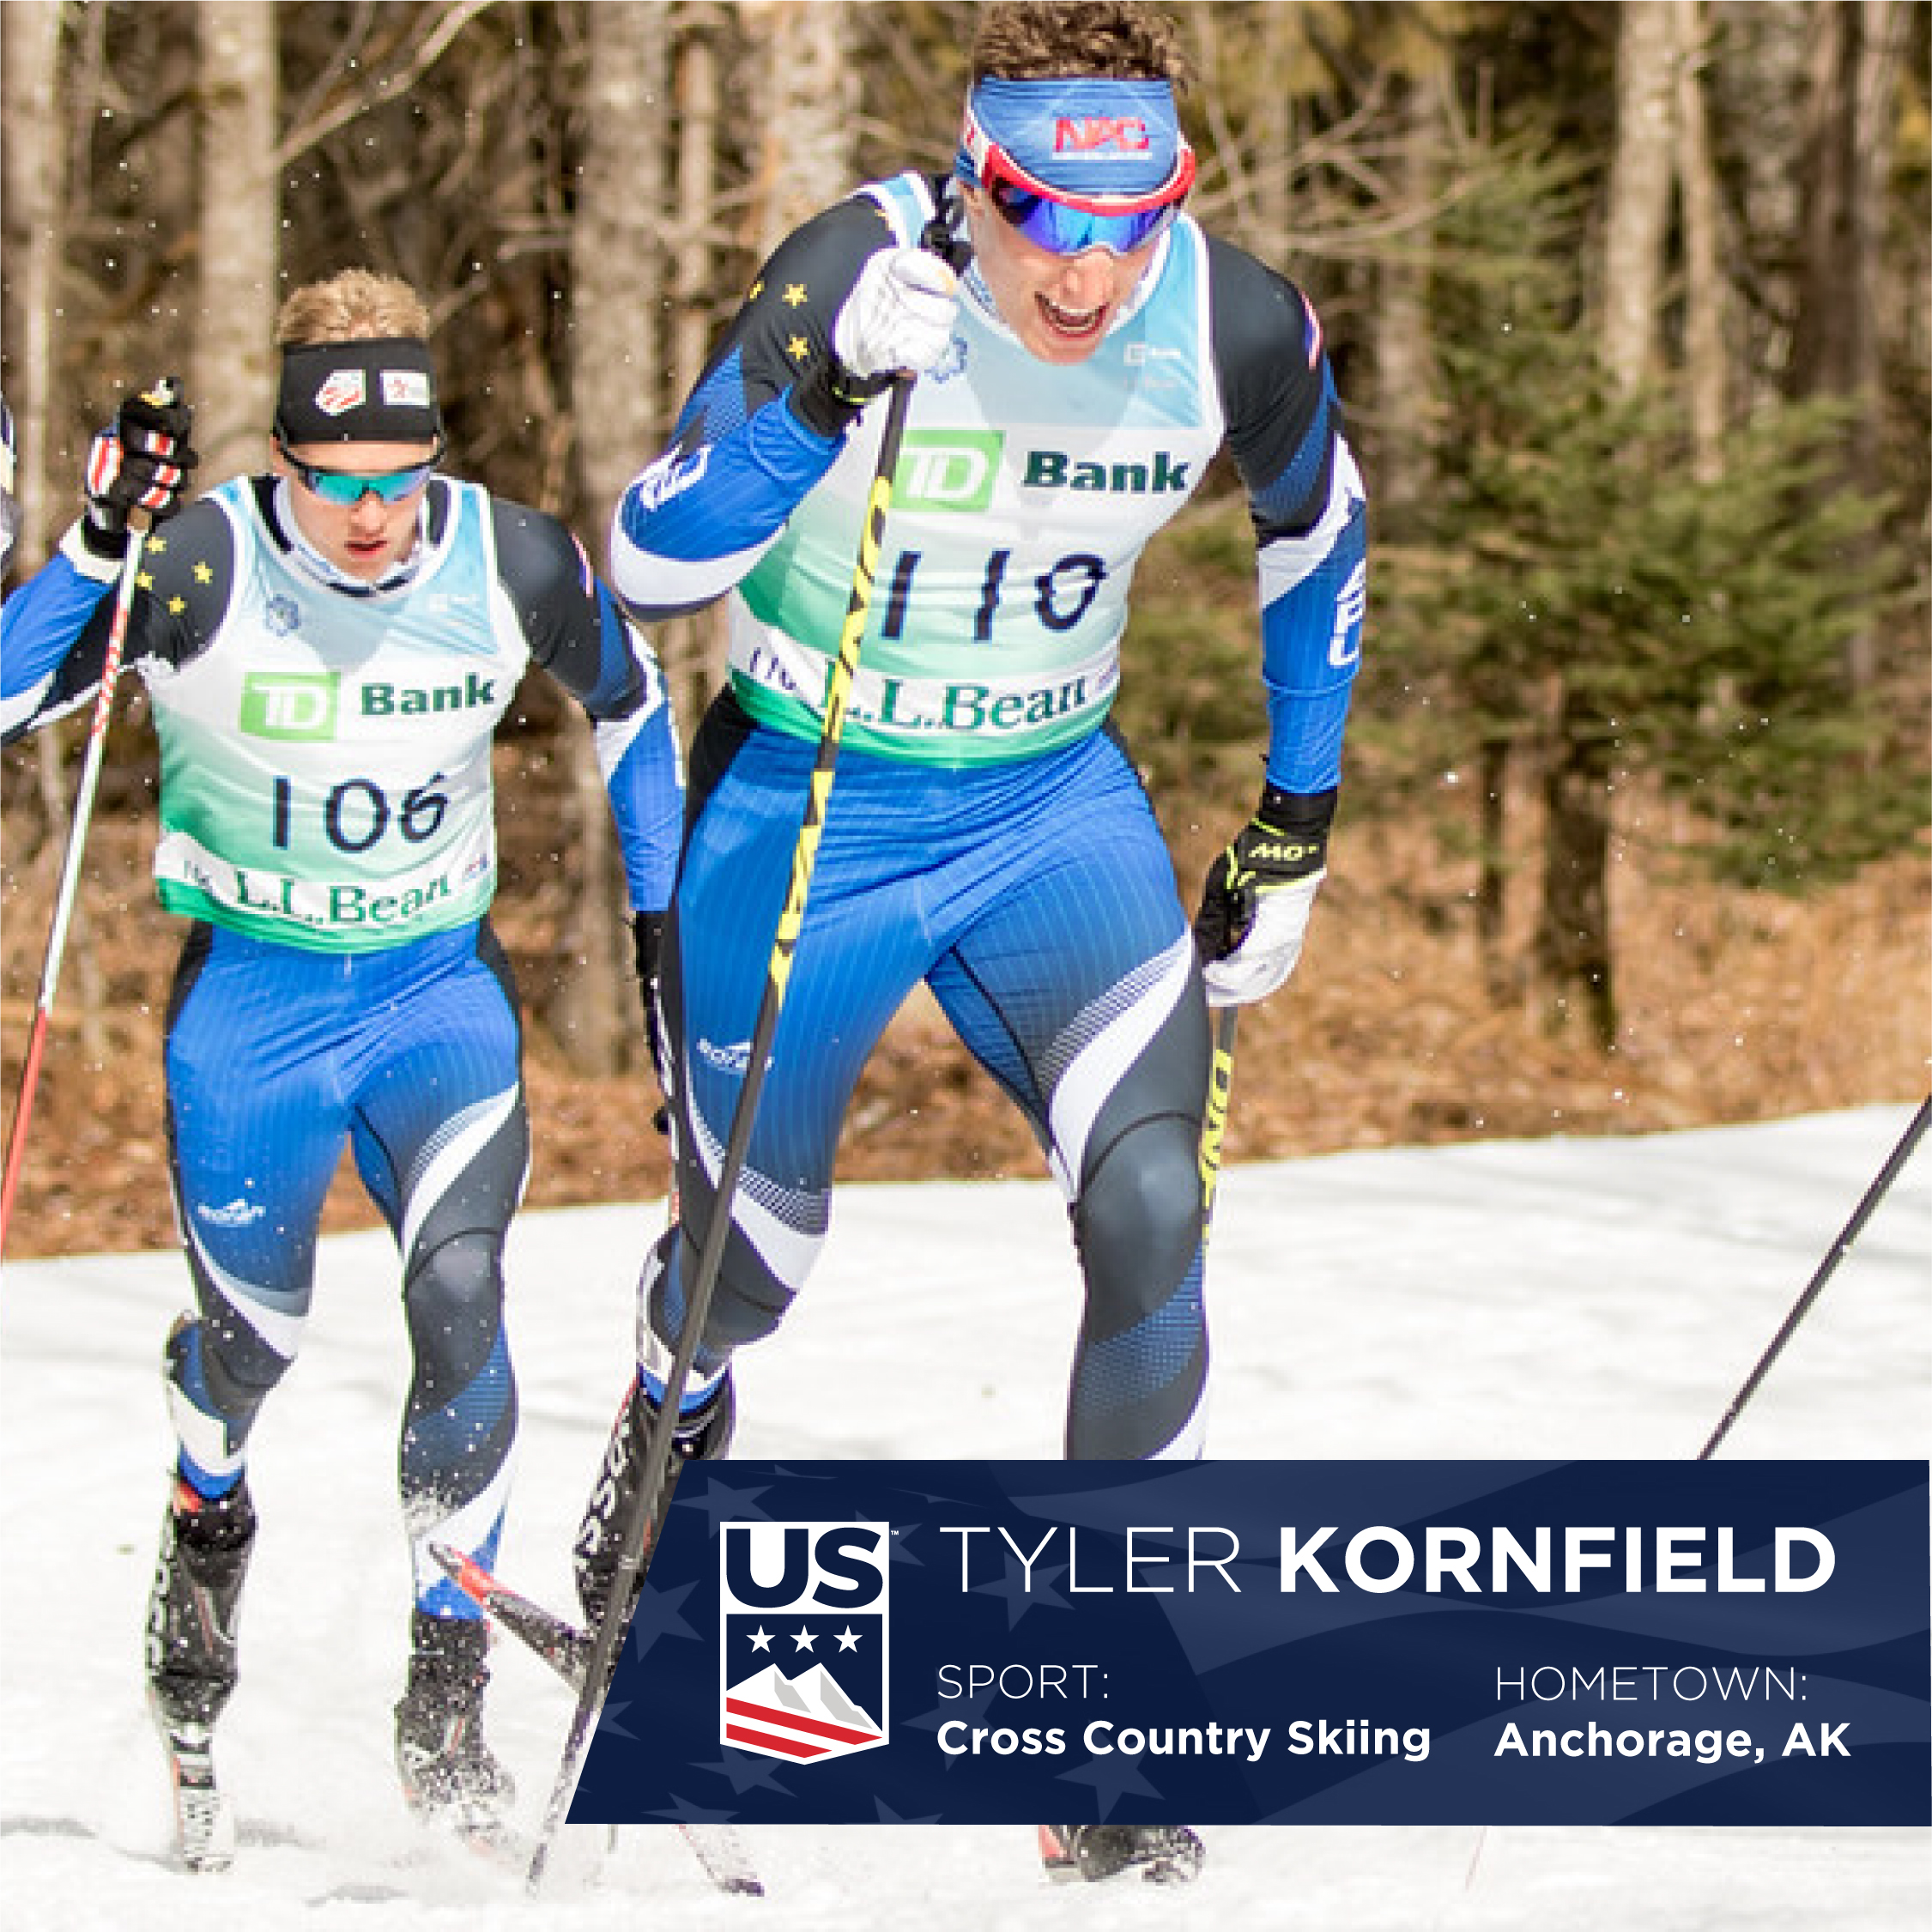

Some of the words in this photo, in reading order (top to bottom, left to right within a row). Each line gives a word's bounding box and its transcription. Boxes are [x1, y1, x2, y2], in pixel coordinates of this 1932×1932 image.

[1021, 451, 1196, 494] Bank
[881, 549, 1110, 641] 110
[360, 672, 496, 716] Bank
[273, 772, 449, 854] 106
